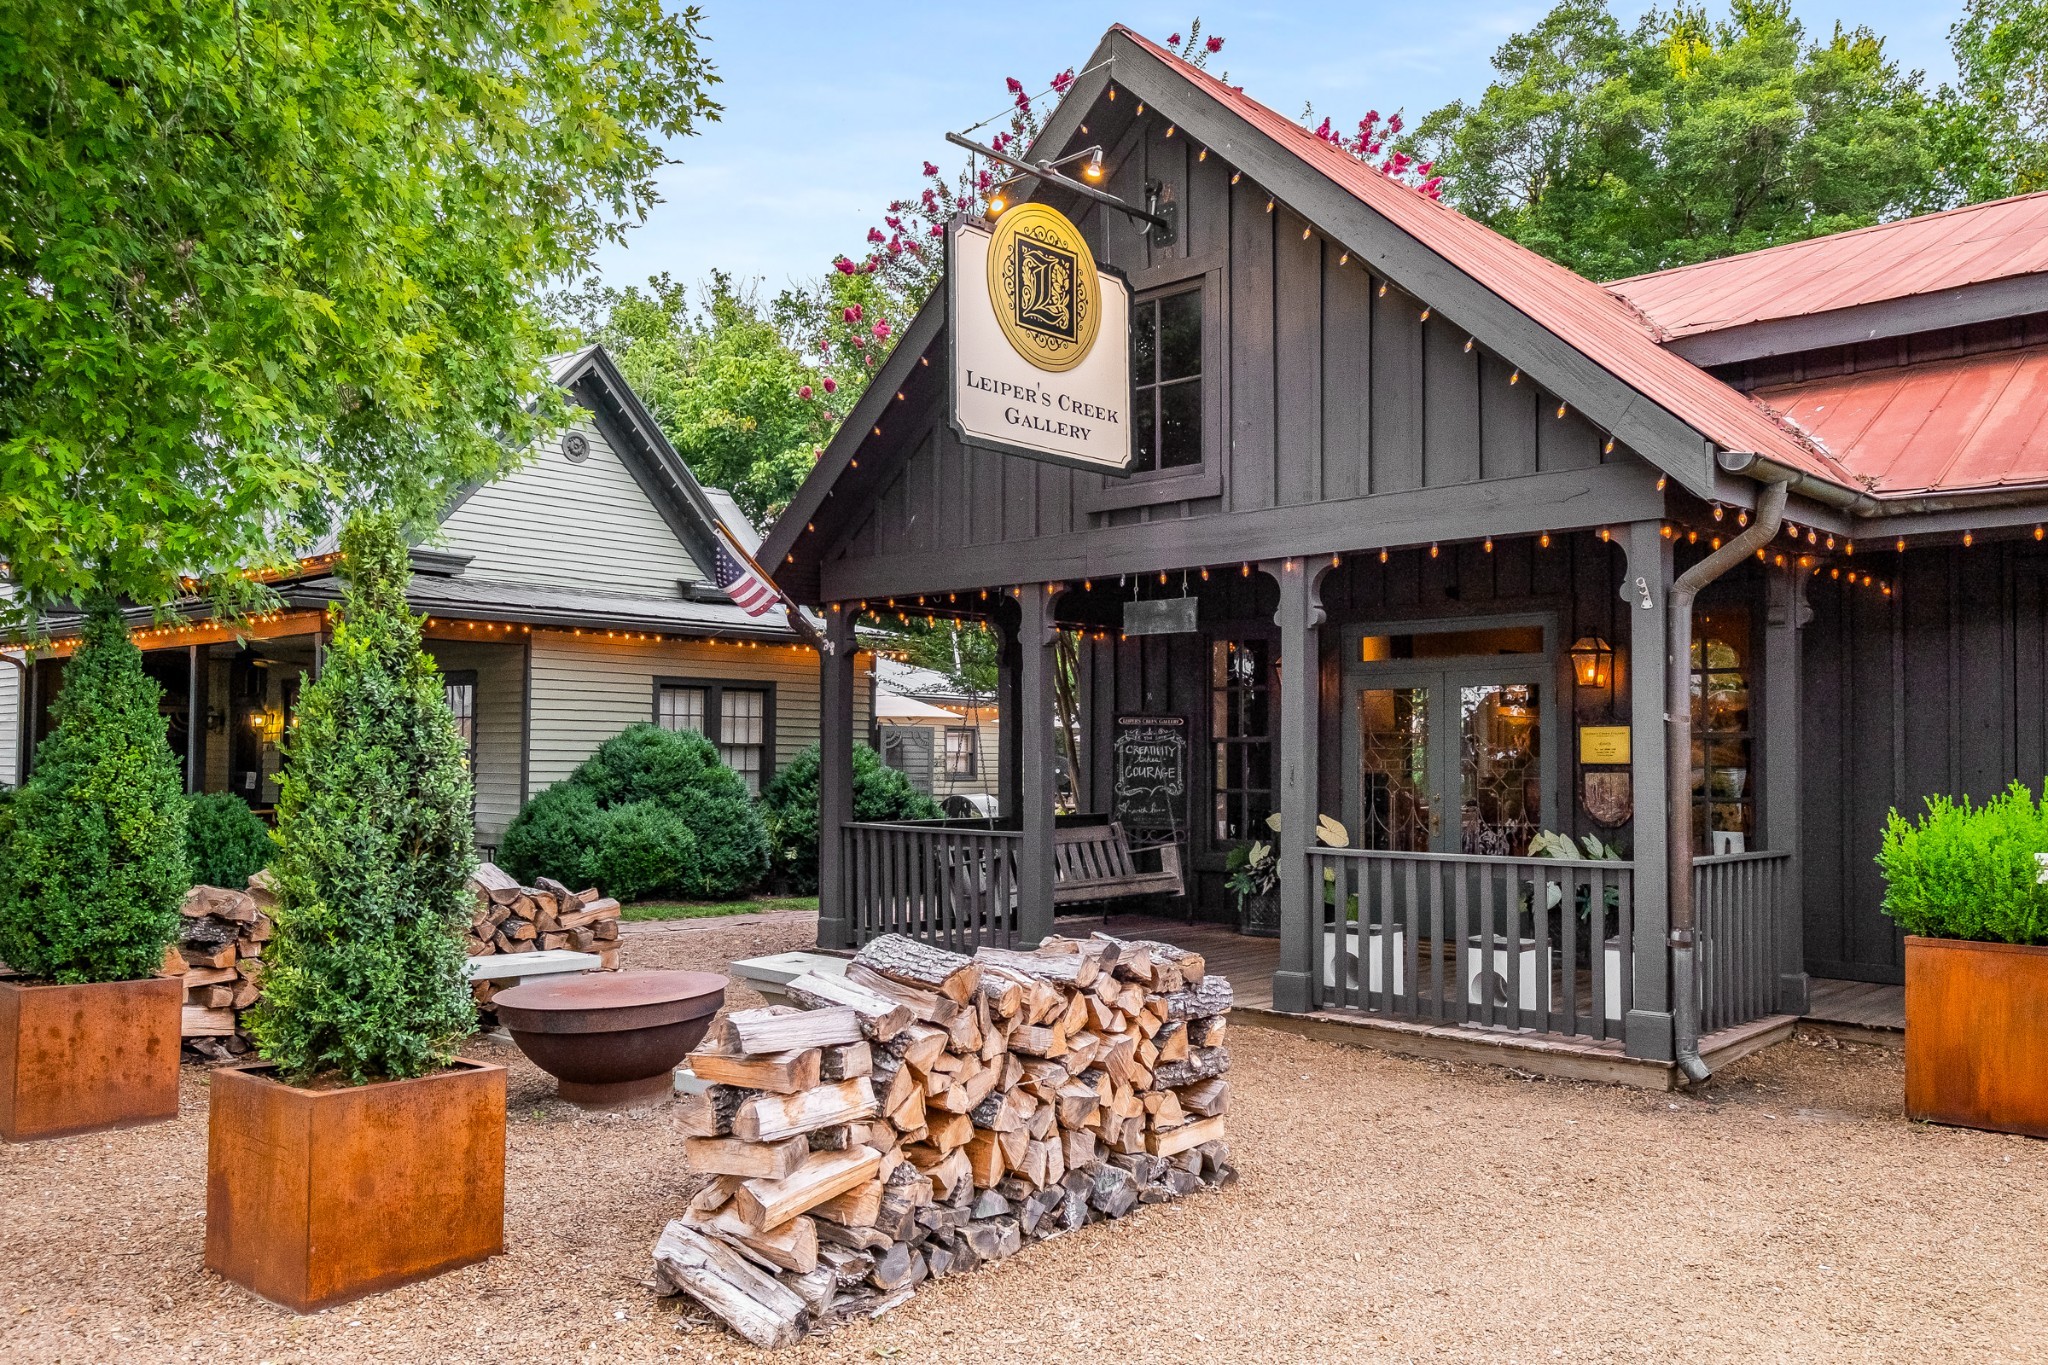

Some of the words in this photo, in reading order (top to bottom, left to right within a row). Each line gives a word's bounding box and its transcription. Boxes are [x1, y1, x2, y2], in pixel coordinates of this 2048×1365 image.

[966, 369, 1051, 407] LEIPER'S
[1058, 393, 1119, 424] CREEK
[1004, 407, 1092, 441] GALLERY
[1125, 745, 1177, 757] CREATIVITY
[1125, 765, 1176, 780] COURAGE
